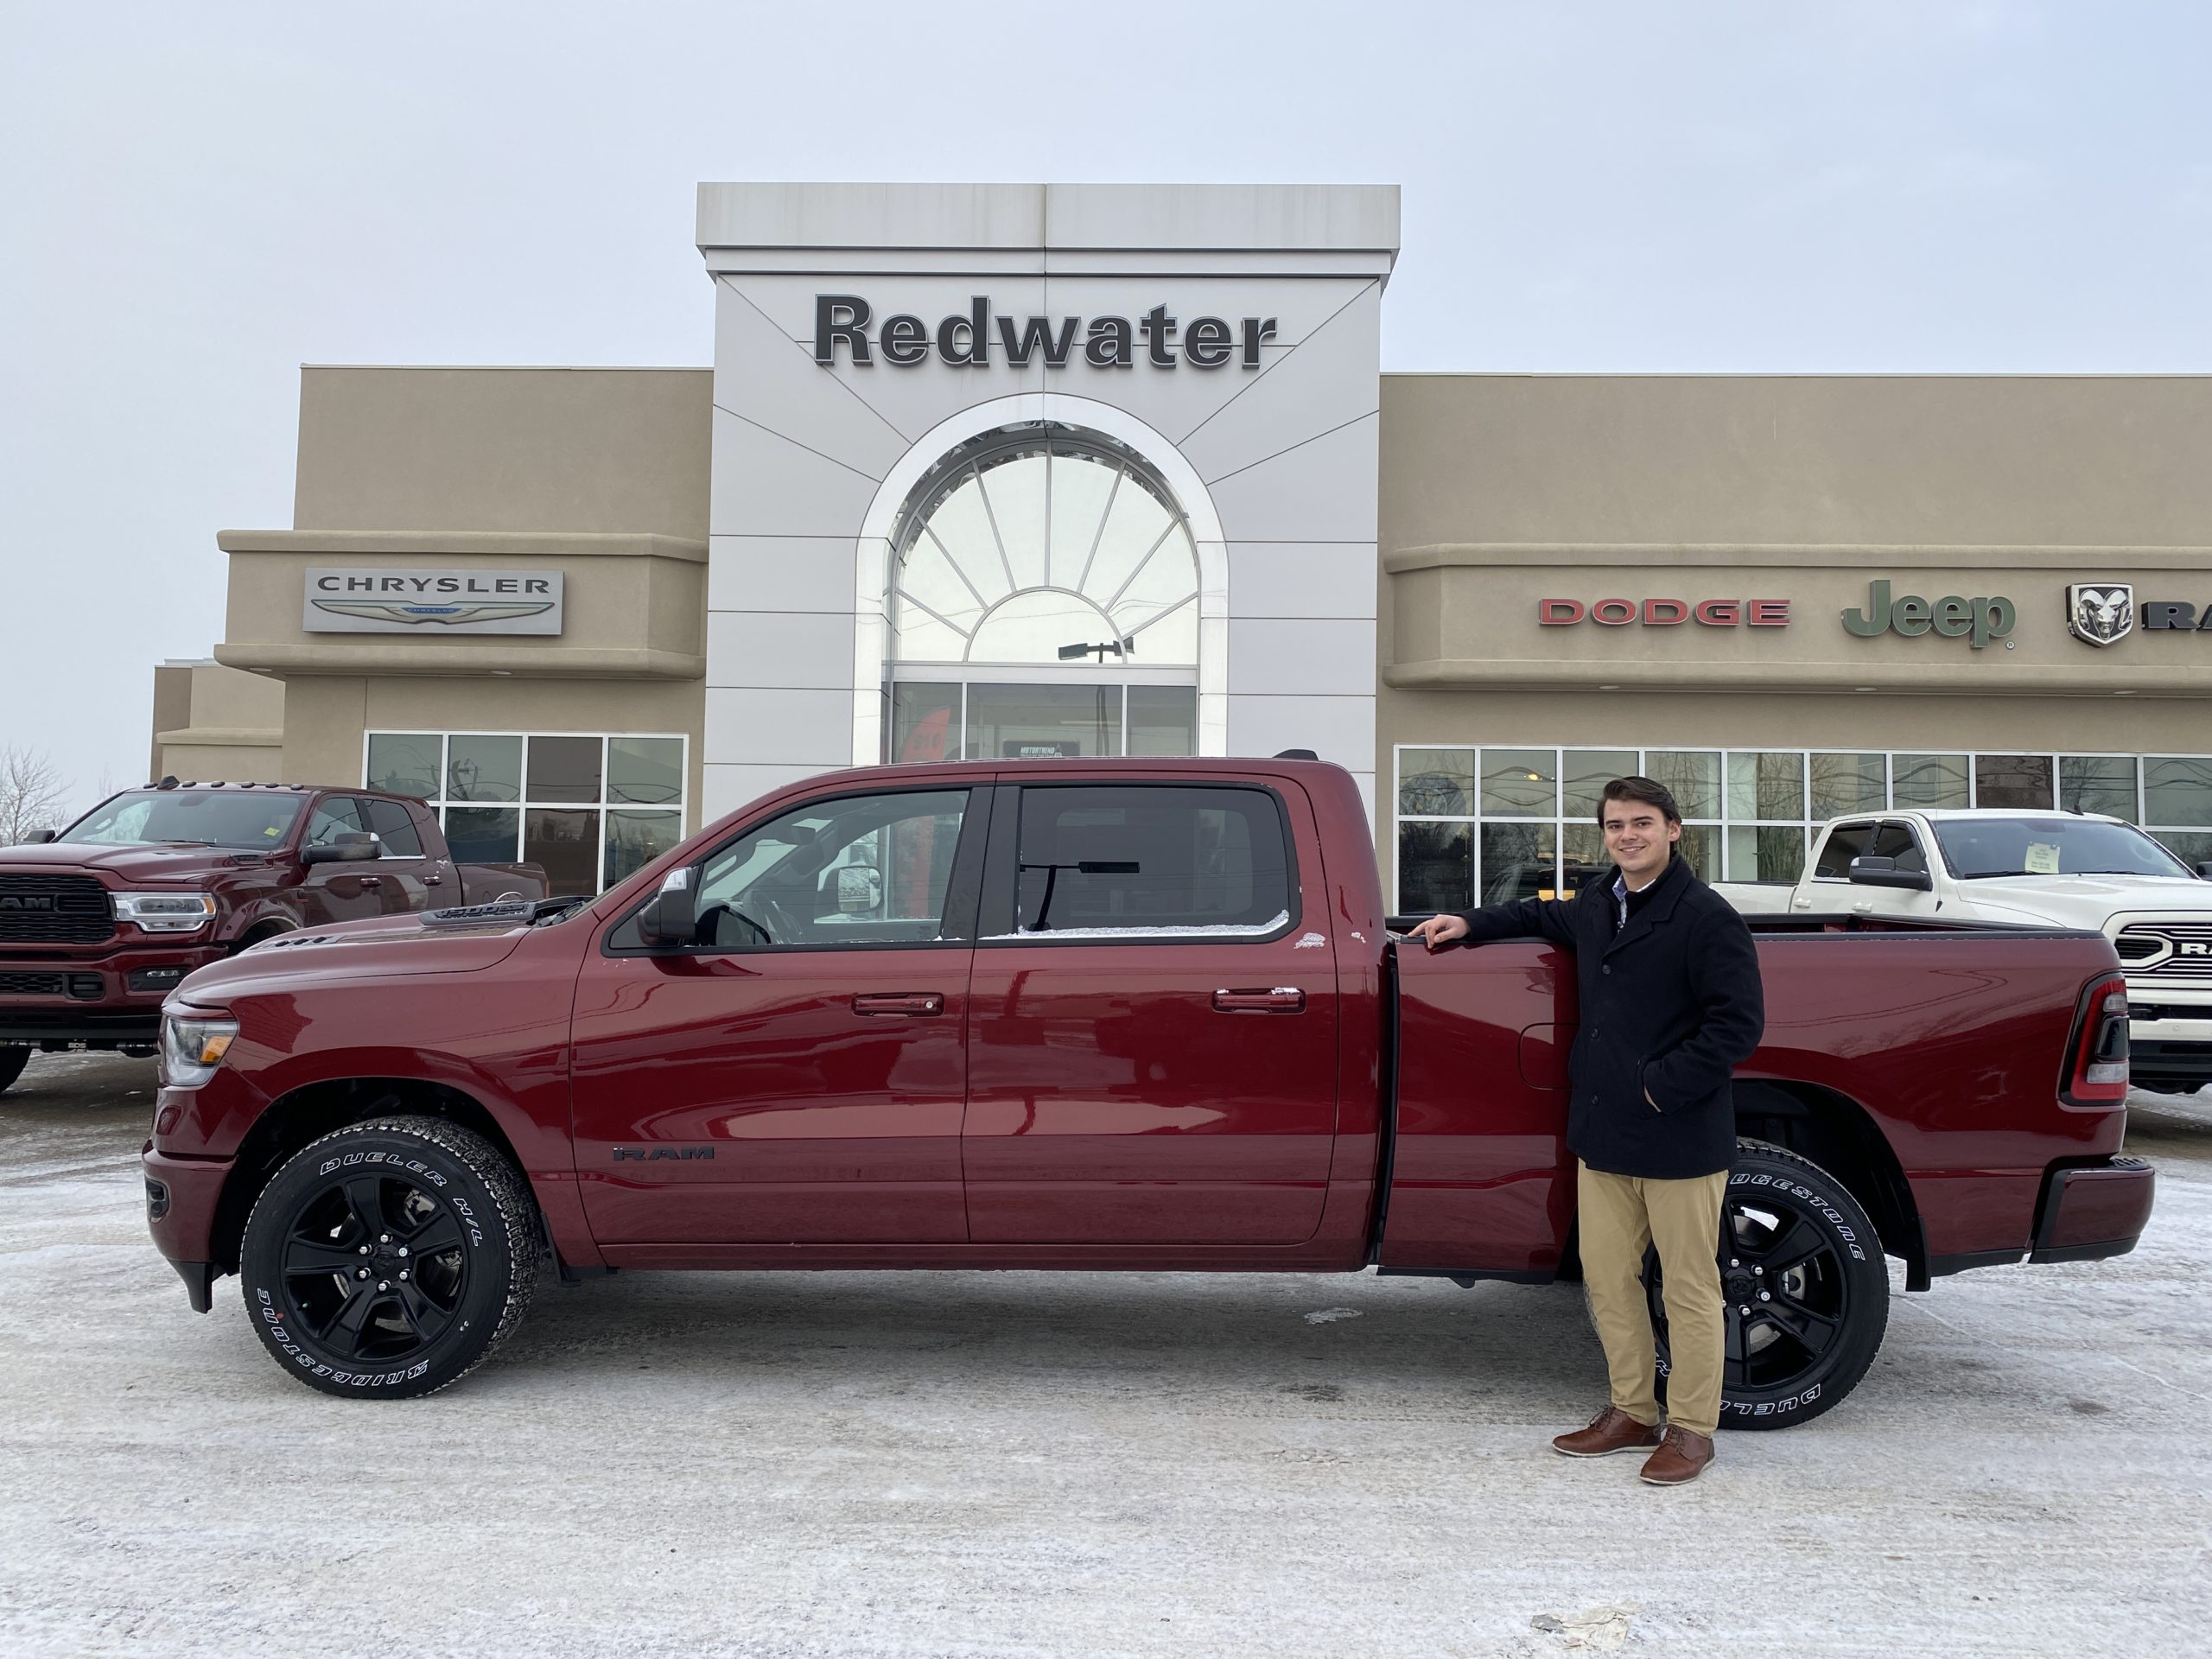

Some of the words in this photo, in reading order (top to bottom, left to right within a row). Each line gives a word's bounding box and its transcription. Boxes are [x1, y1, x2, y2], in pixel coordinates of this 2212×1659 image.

[814, 294, 1277, 369] Redwater
[317, 575, 550, 594] CHRYSLER
[1539, 598, 1791, 626] DODGE
[1841, 580, 2017, 649] Jeep
[2141, 601, 2212, 630] R
[0, 897, 51, 909] AM
[2181, 943, 2212, 955] R
[320, 1152, 448, 1187] DUELER
[613, 1147, 715, 1161] RAM
[1730, 1173, 1866, 1262] DGESTONE
[257, 1287, 429, 1387] BRIDGESTONE
[1719, 1383, 1821, 1416] DUEL
